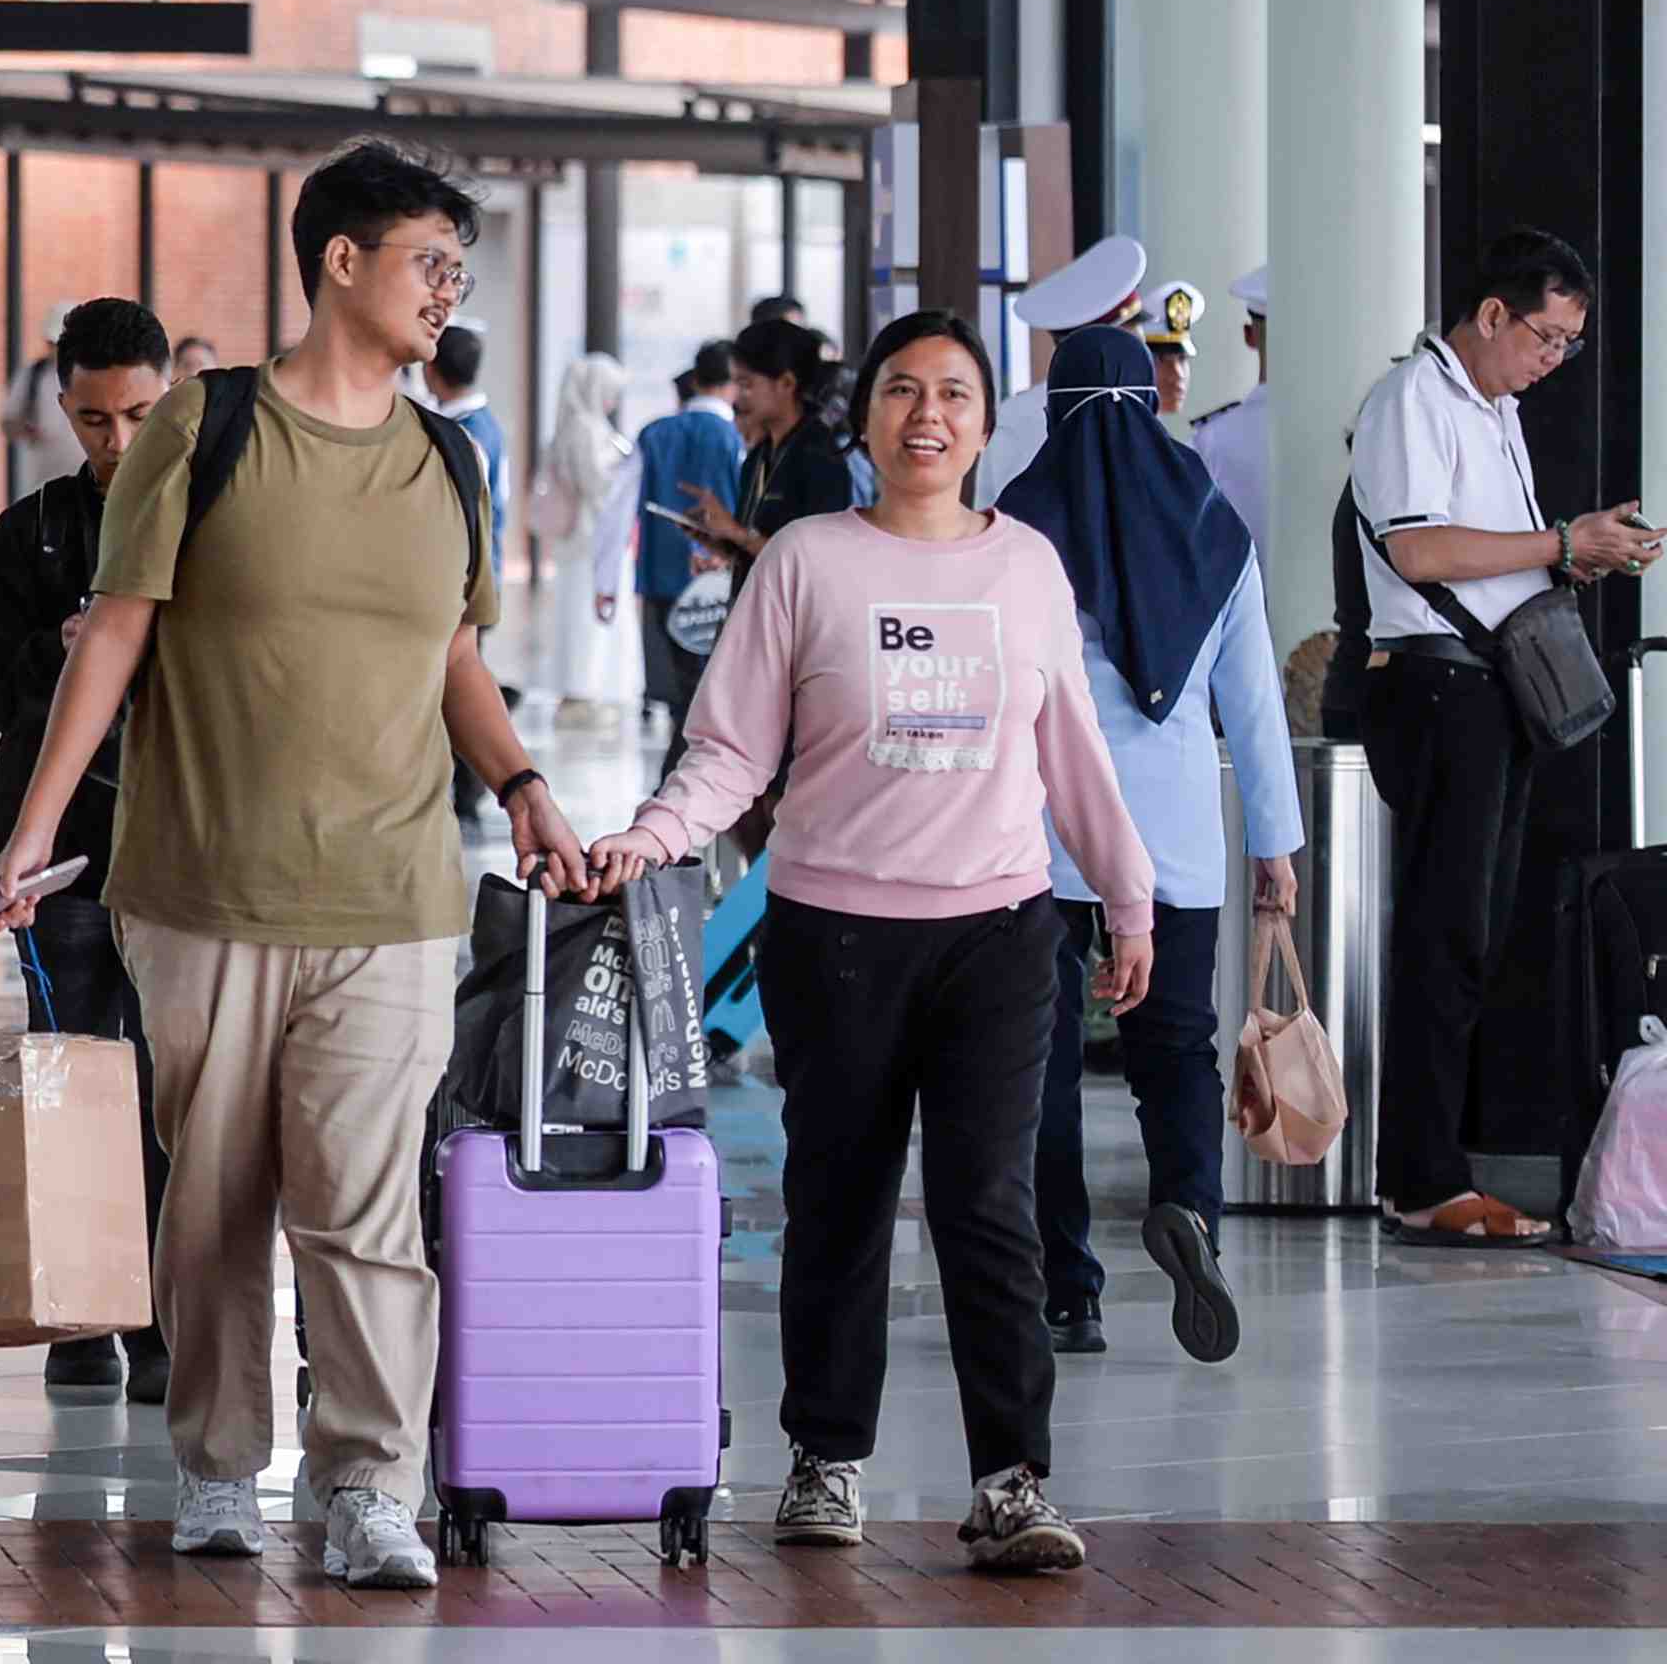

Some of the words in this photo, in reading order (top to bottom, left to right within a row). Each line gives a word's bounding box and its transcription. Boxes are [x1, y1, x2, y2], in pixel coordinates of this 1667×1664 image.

[879, 616, 935, 652] Be
[906, 728, 945, 740] taken
[590, 944, 634, 975] Mc
[574, 995, 626, 1026] ald's
[565, 1019, 627, 1060] McD
